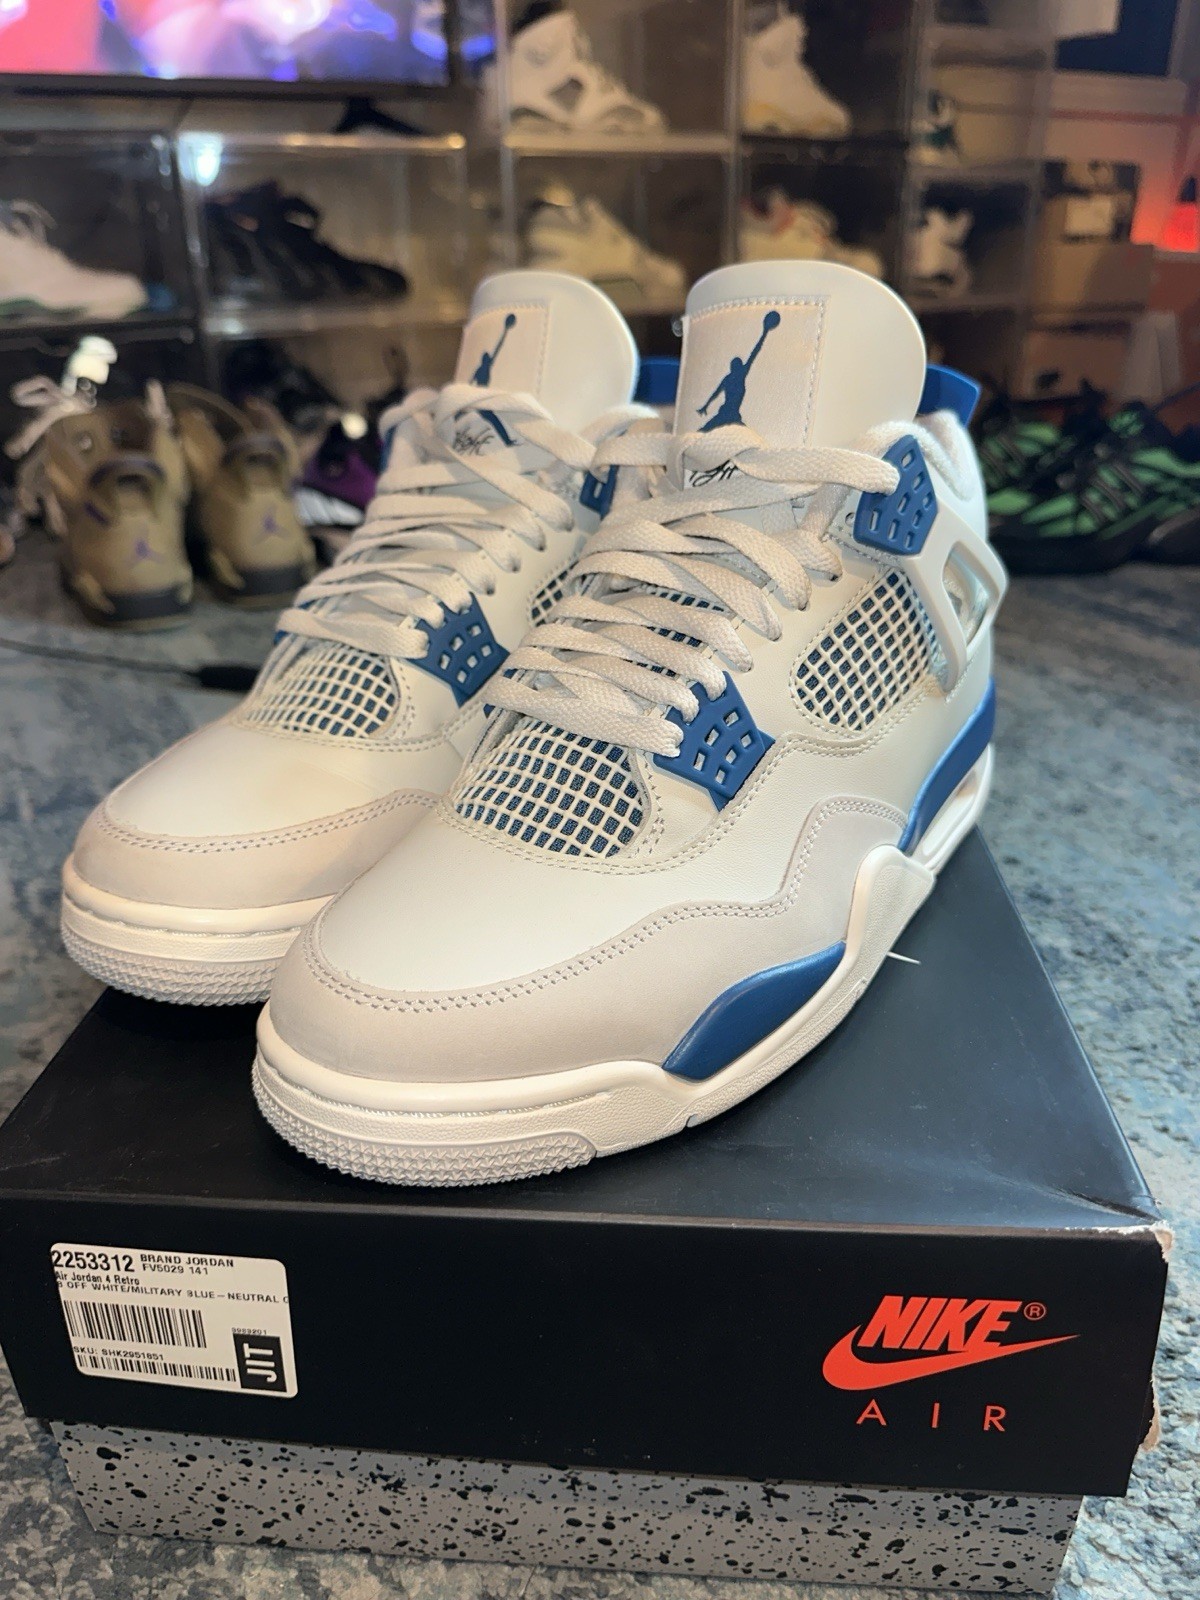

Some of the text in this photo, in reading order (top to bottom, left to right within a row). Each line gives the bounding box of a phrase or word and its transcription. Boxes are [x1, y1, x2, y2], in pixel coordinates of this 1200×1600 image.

[51, 1250, 234, 1272] 2253312 BRAND JORDAN
[142, 1263, 209, 1275] FV5029 141
[67, 1281, 87, 1289] OFF
[72, 1273, 102, 1282] Jordan
[105, 1275, 111, 1283] 4
[113, 1275, 140, 1285] Retro
[857, 1295, 1023, 1352] NIKE
[73, 1346, 98, 1355] SKU:
[243, 1342, 277, 1383] JIT
[856, 1399, 1006, 1431] AIR
